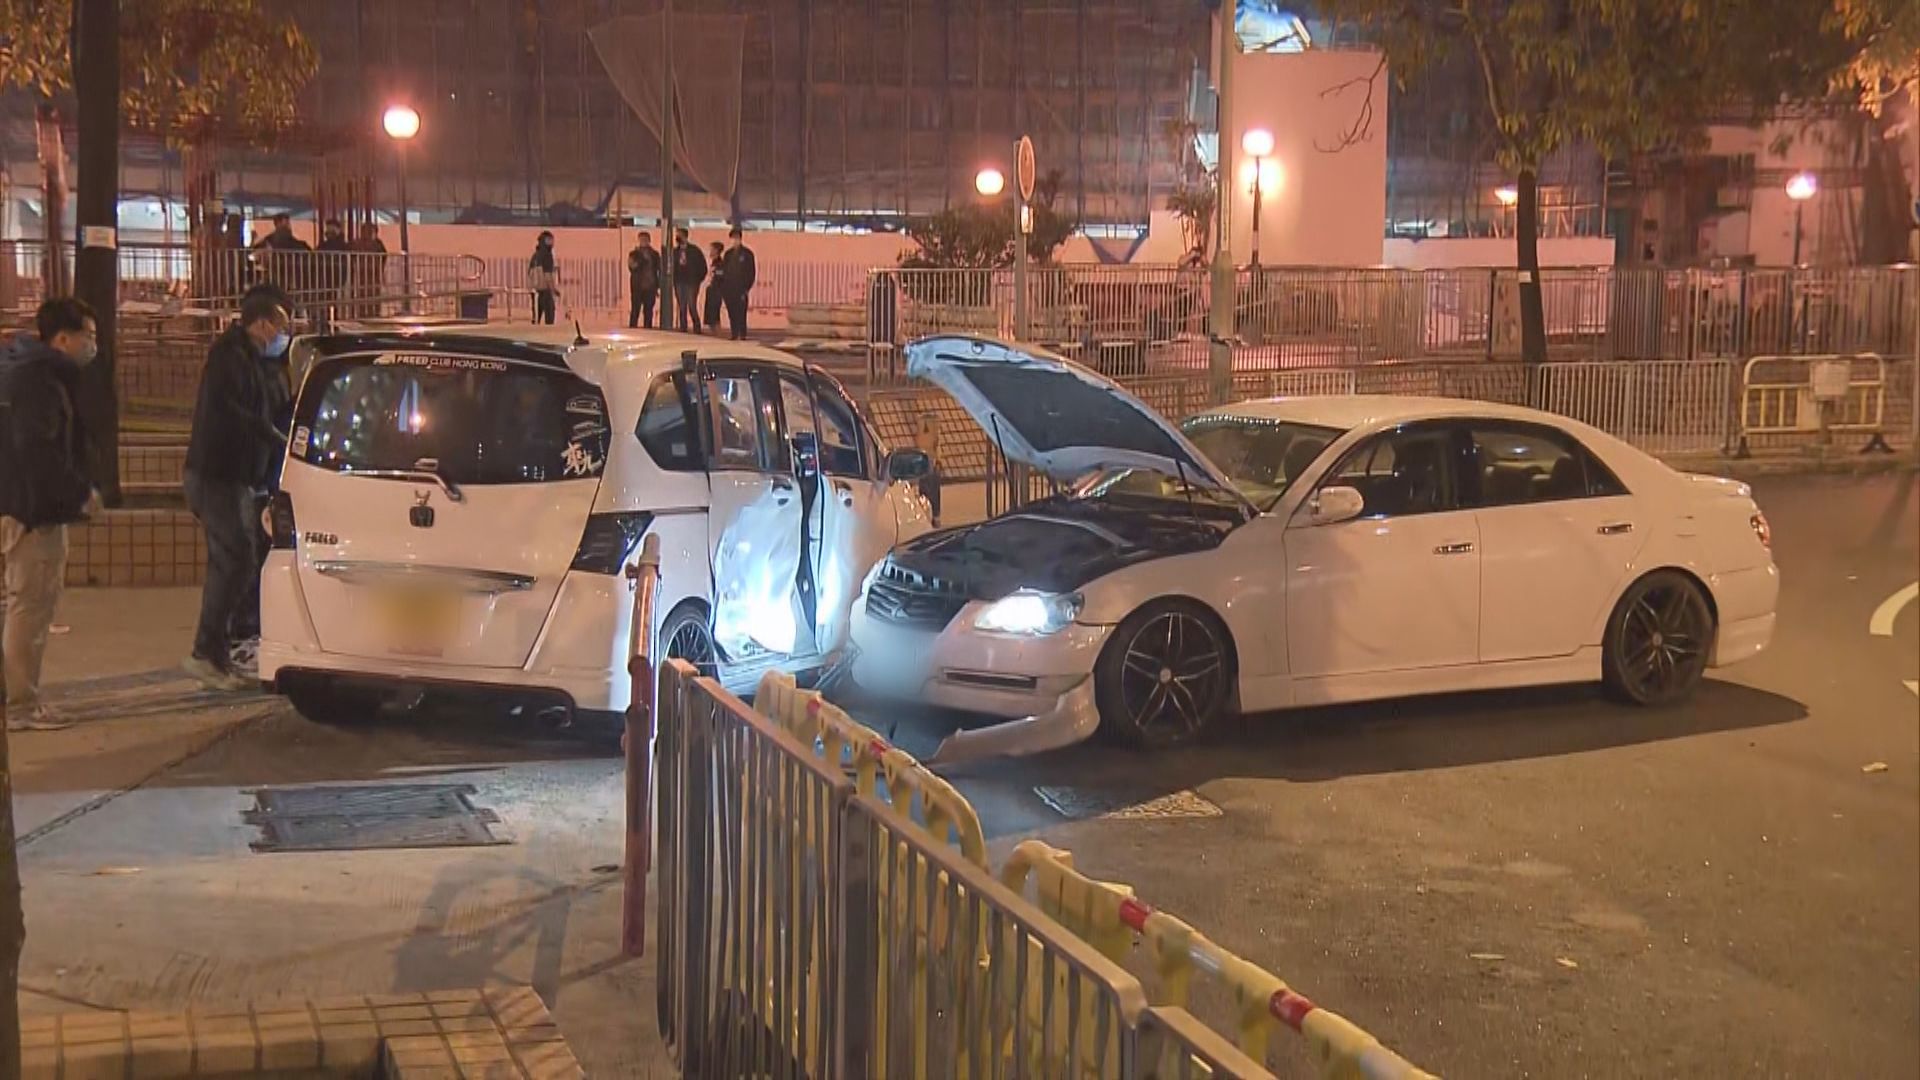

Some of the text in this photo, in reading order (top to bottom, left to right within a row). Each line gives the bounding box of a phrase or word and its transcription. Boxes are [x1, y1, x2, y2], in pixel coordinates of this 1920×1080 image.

[397, 355, 507, 371] FREED CLUB HONG KONG
